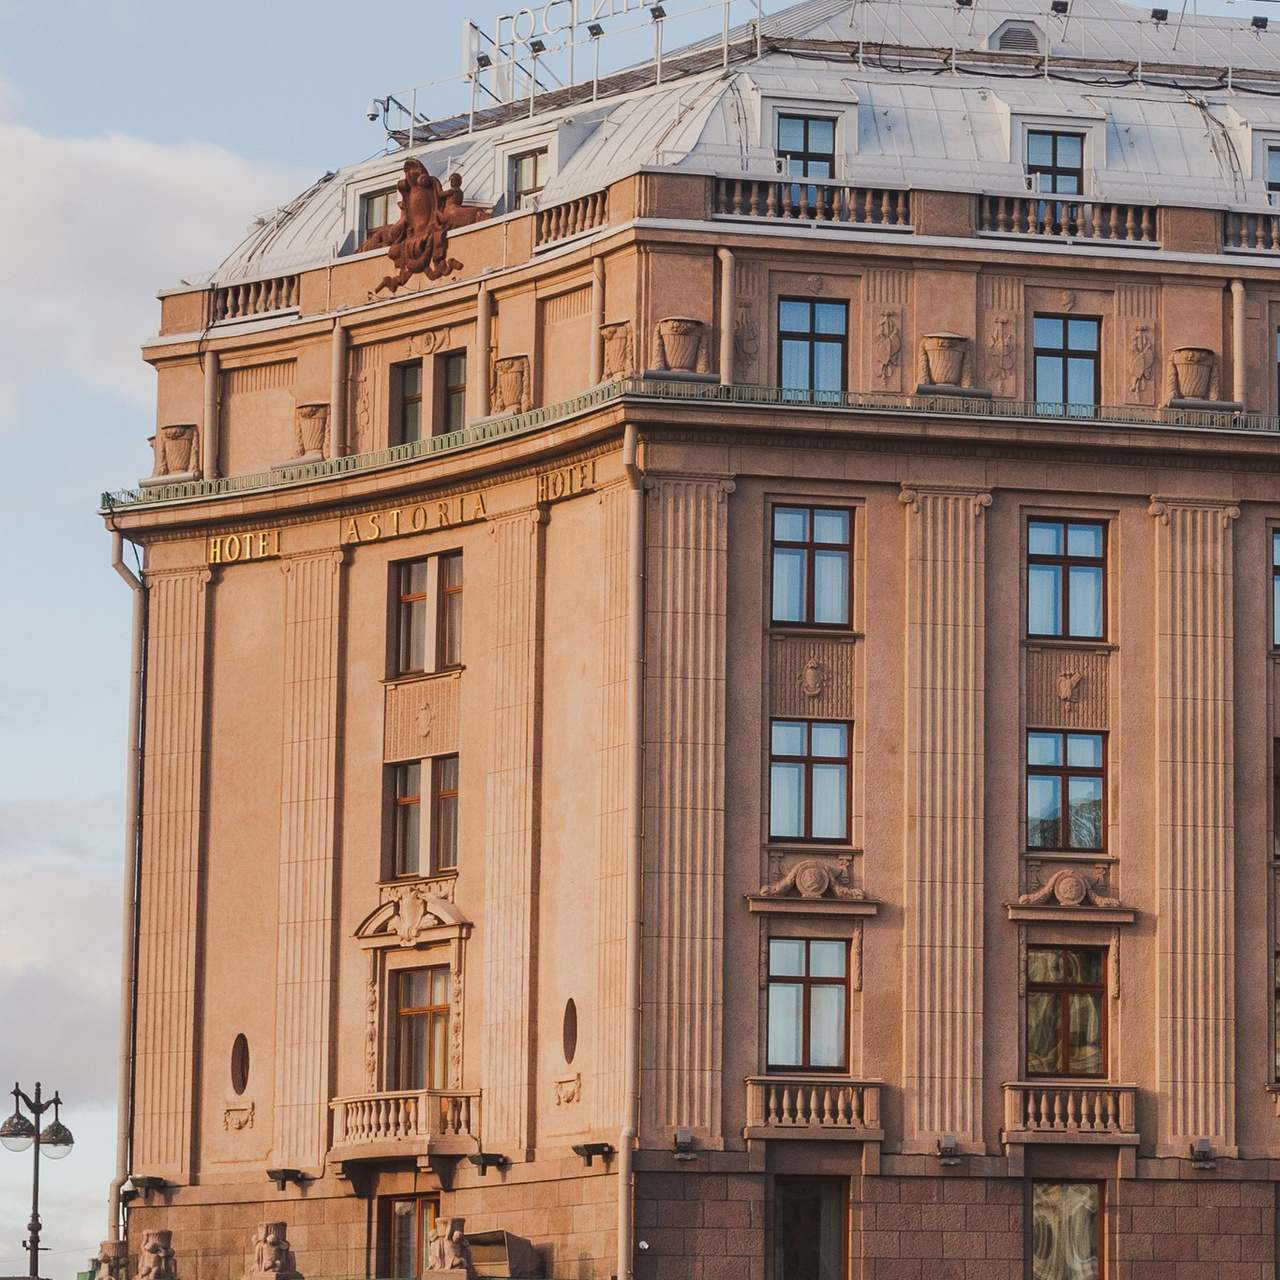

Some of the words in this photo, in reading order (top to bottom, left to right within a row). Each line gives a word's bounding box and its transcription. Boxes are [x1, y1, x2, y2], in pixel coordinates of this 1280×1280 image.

[210, 531, 282, 564] HOTEL
[345, 492, 487, 543] ASTORIA
[538, 460, 598, 502] HOTEL
